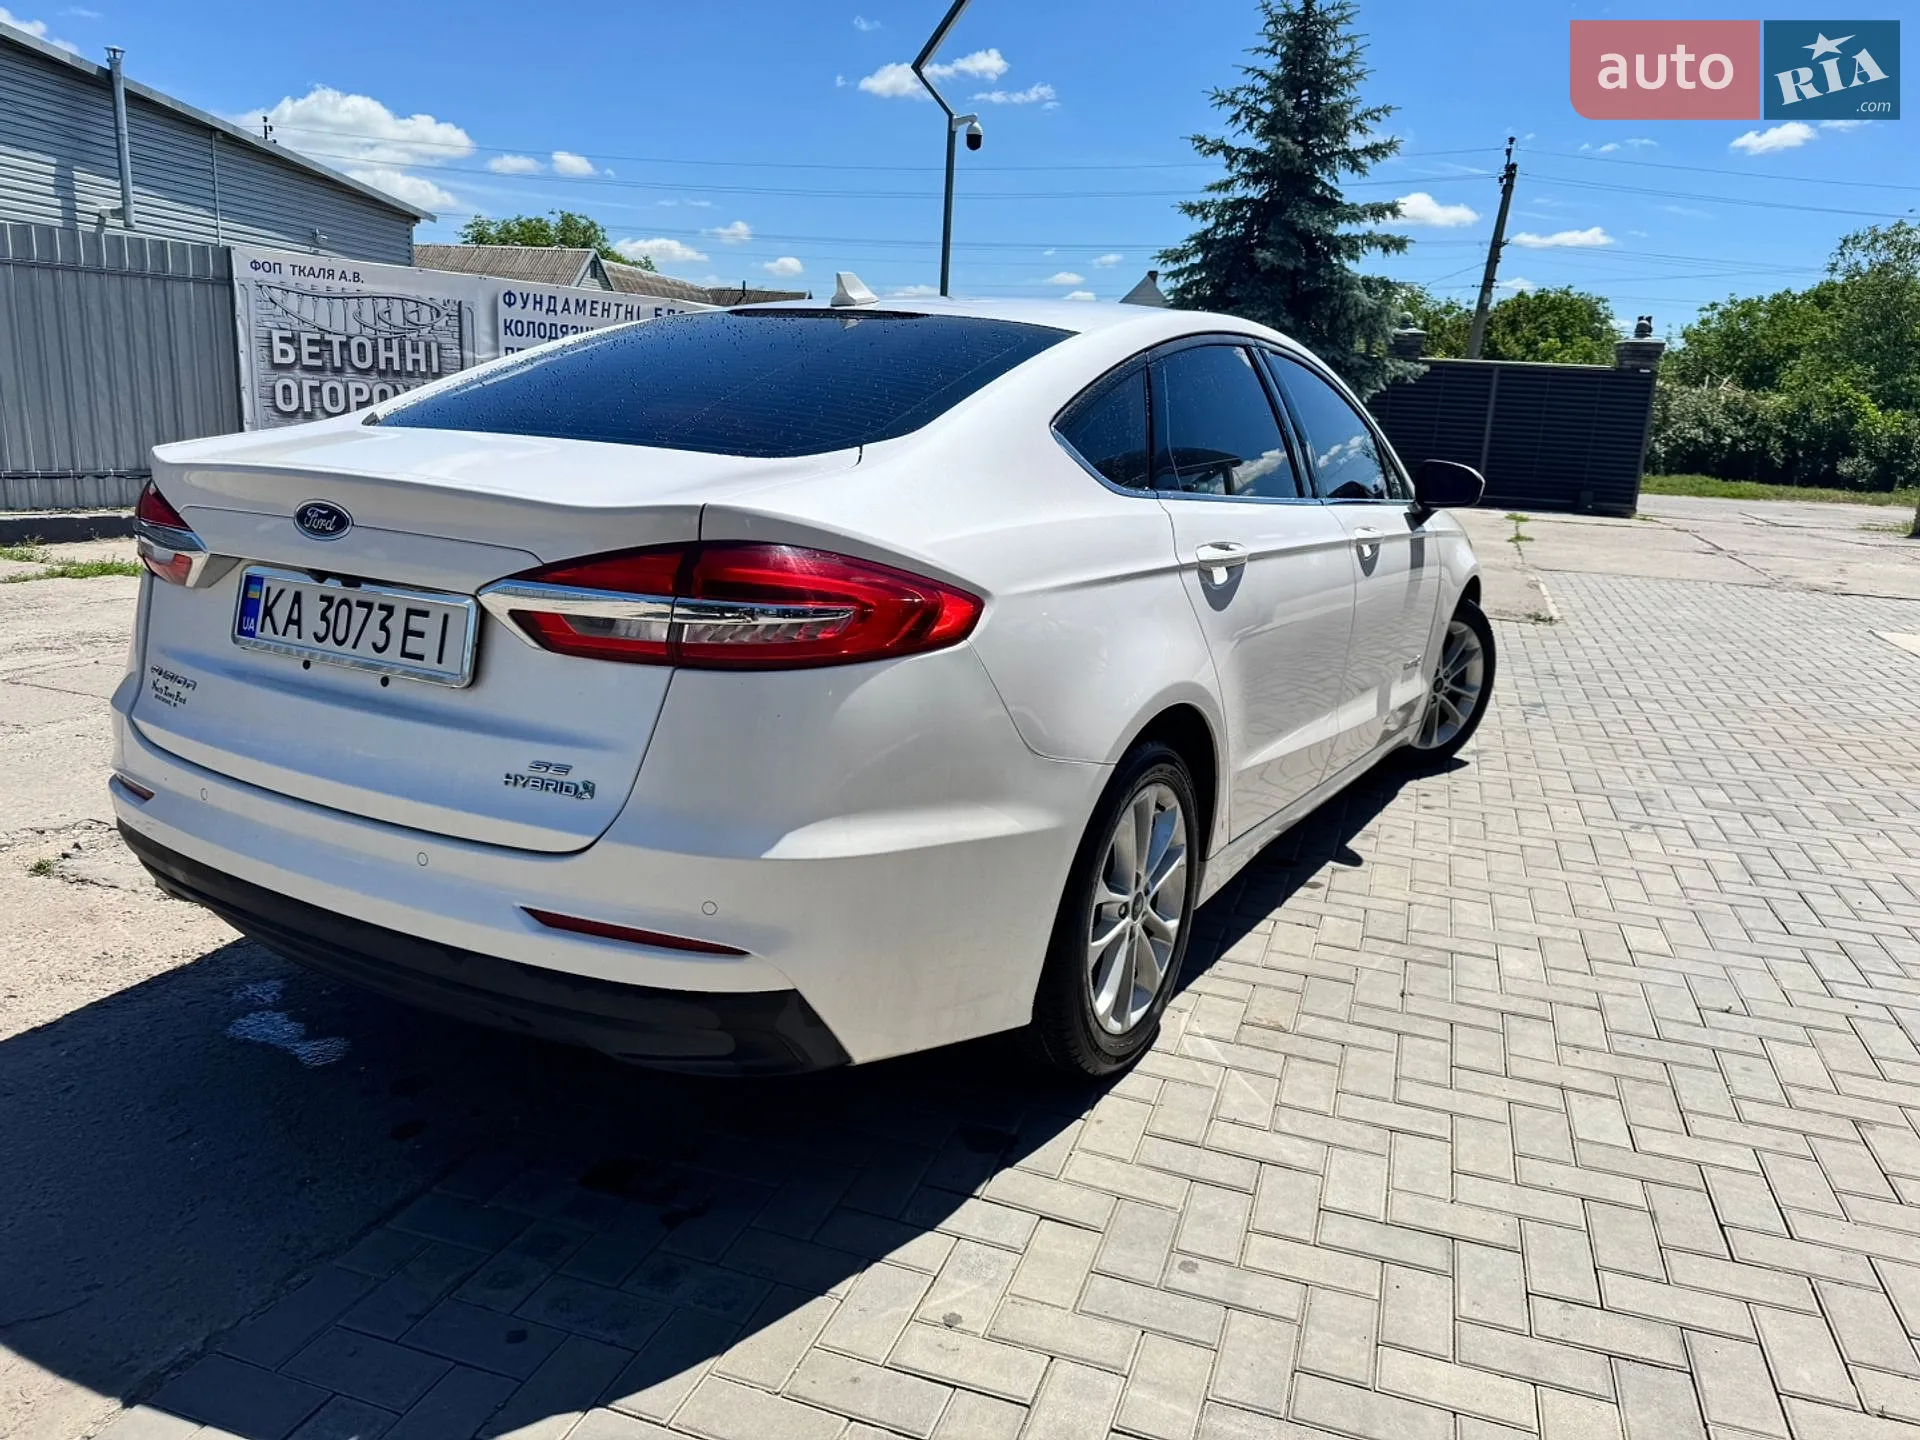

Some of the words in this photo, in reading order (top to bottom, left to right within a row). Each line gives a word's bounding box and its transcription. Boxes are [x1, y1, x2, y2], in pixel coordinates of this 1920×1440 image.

[250, 259, 283, 275] ФОП
[289, 263, 335, 281] ТКАЛЯ
[338, 269, 364, 284] А.В.
[502, 289, 641, 321] ФУНДАМЕНТНІ
[270, 329, 441, 374] БЕТОННІ
[304, 506, 338, 531] Ford
[242, 615, 255, 632] UA
[260, 586, 303, 640] KA
[527, 760, 573, 776] SE
[503, 772, 580, 798] HYBRID
